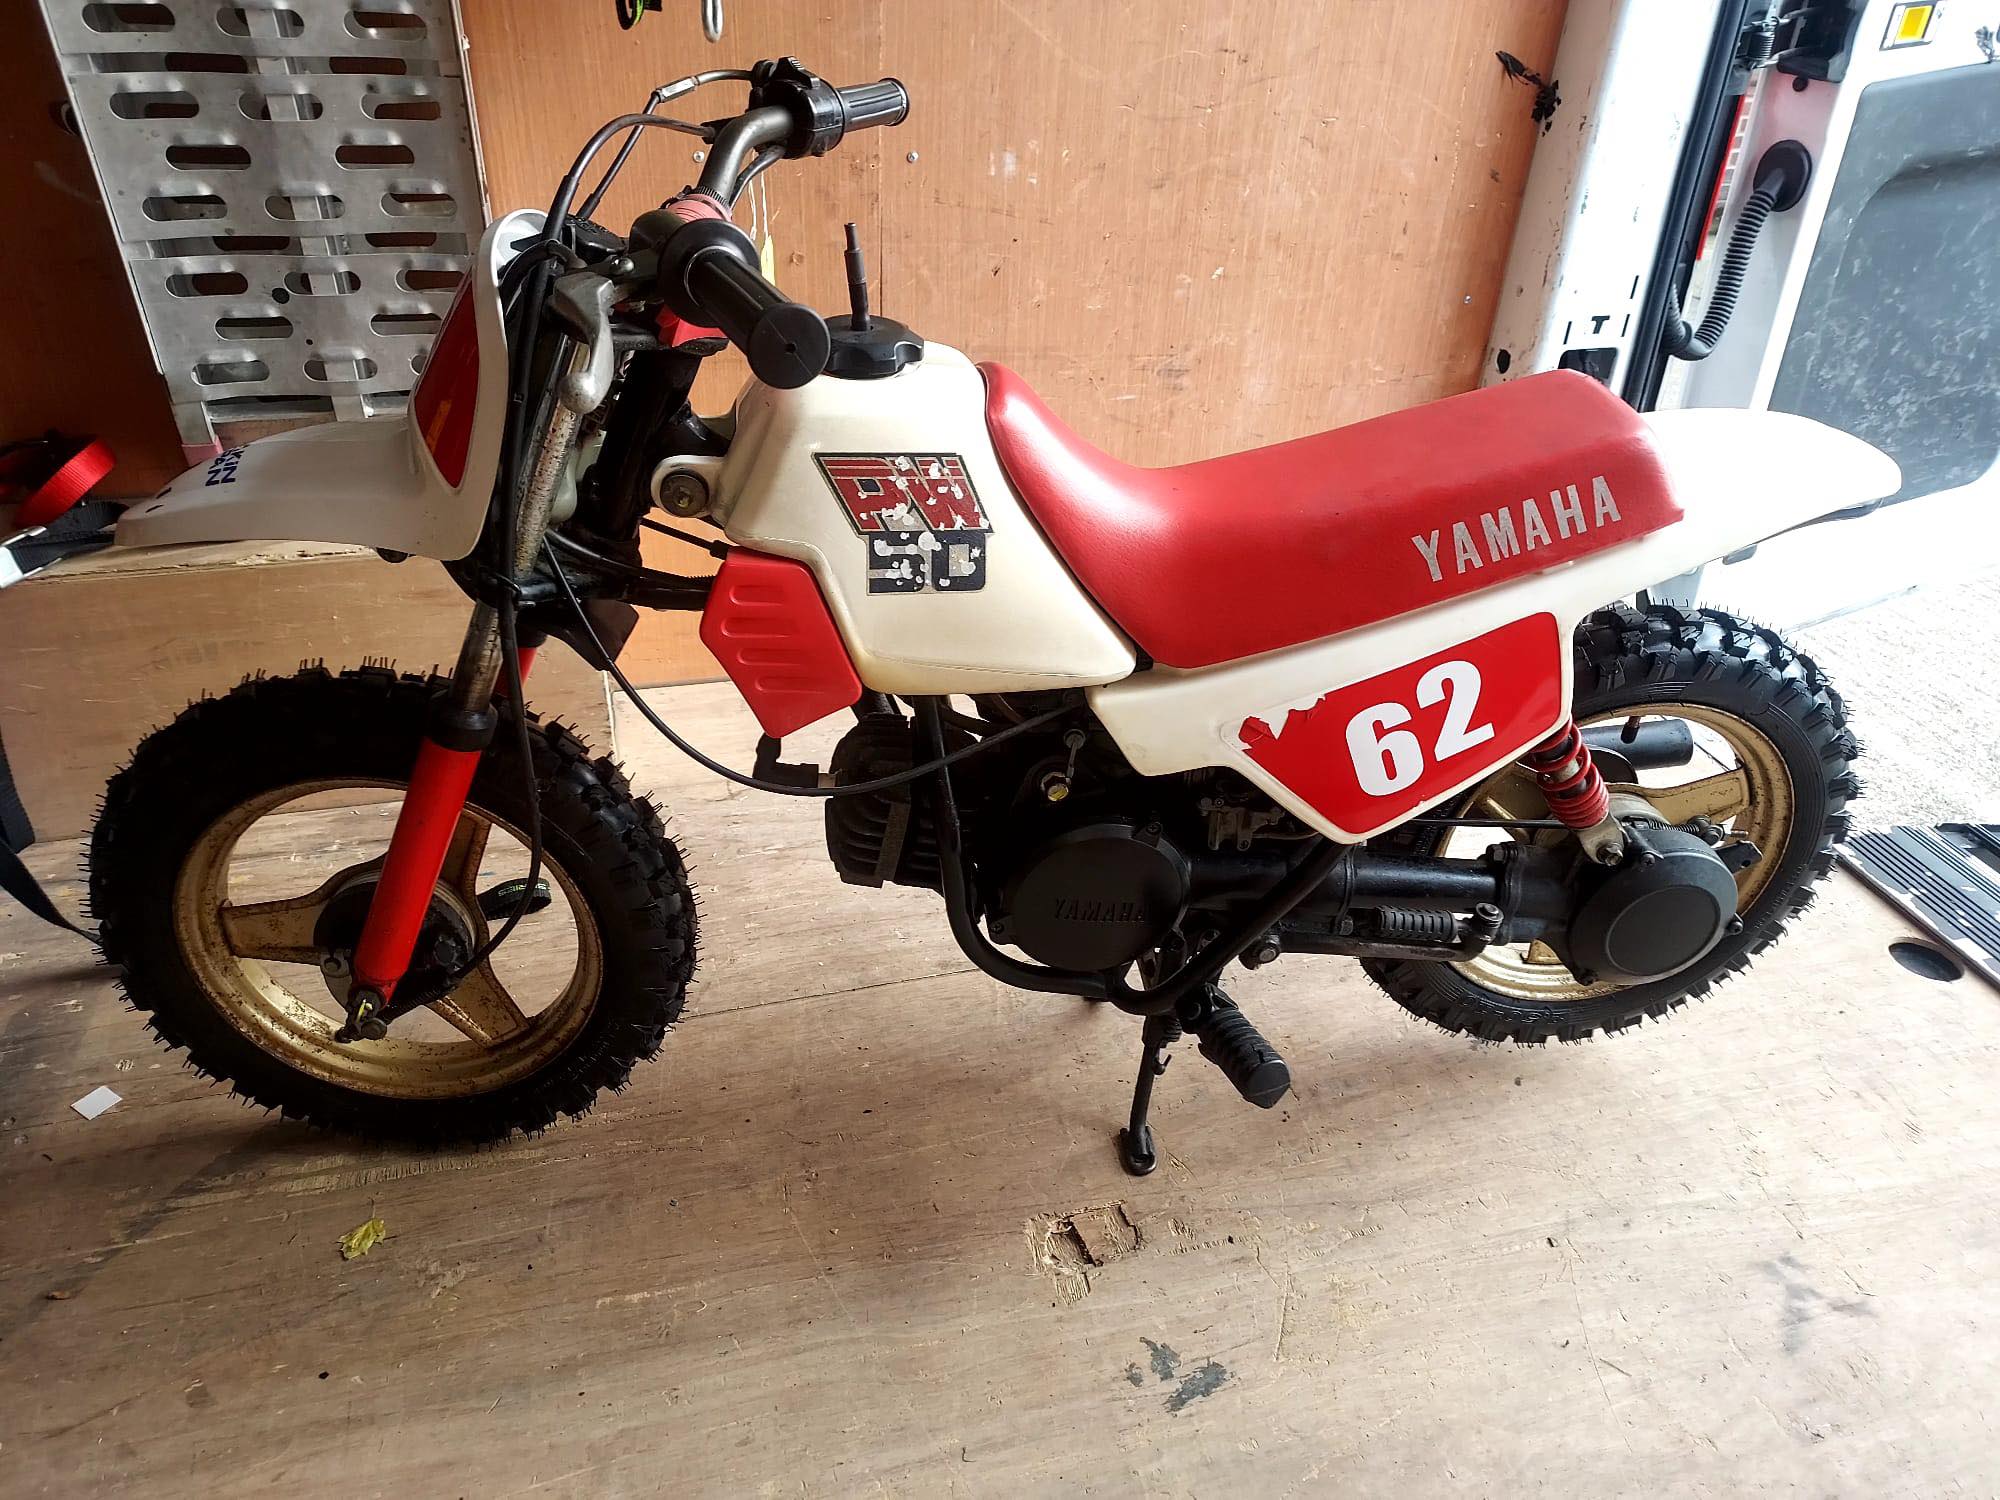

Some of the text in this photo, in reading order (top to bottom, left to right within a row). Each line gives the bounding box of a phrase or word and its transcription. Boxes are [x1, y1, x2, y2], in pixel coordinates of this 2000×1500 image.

[1411, 475, 1621, 582] YAMAHA
[1345, 660, 1495, 796] 62
[1054, 898, 1150, 924] YAMAHA
